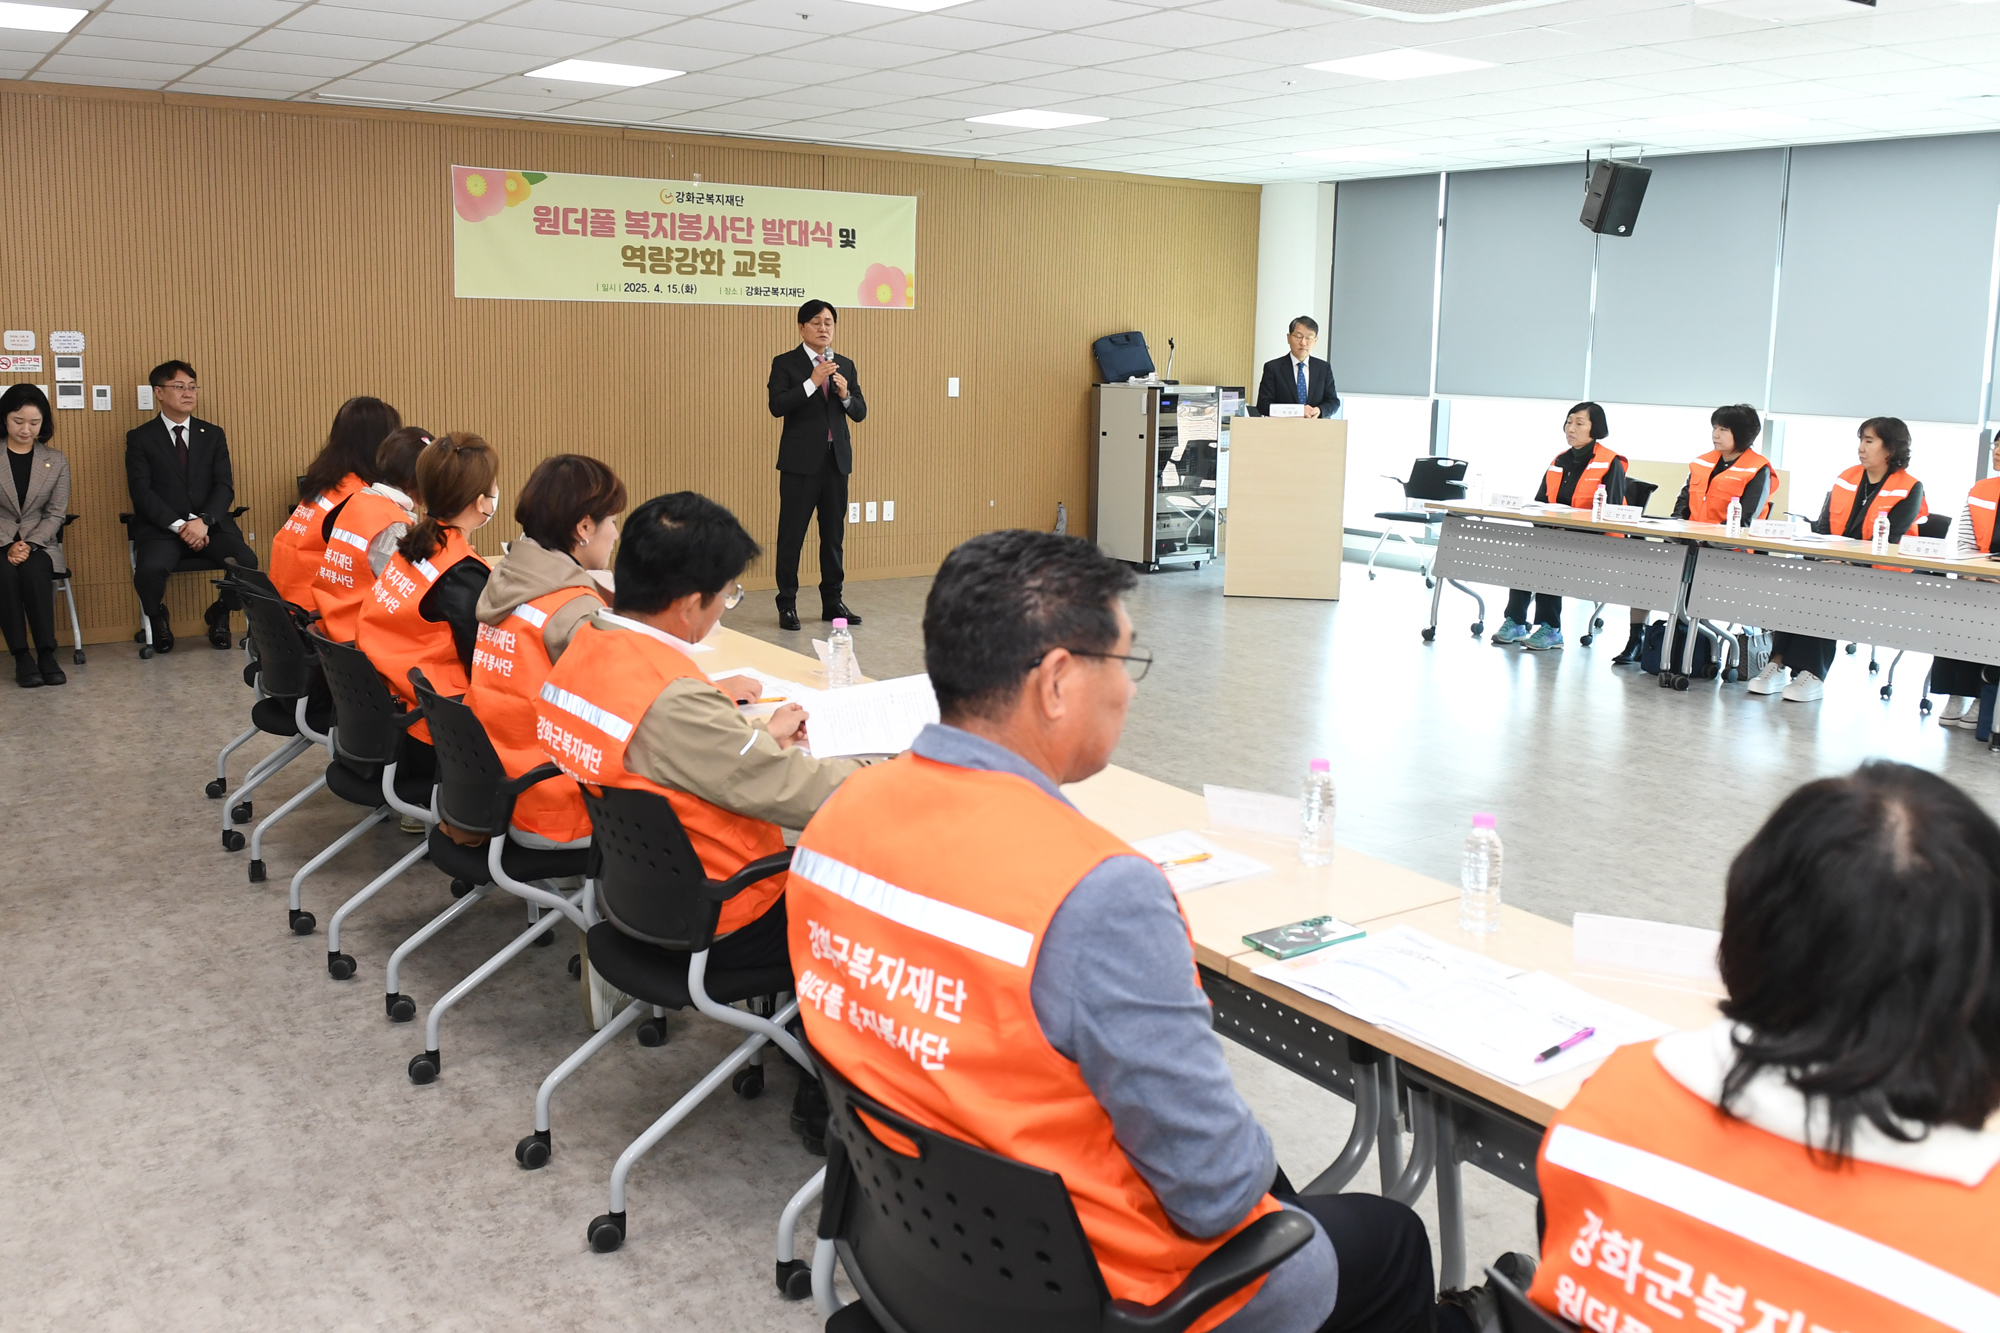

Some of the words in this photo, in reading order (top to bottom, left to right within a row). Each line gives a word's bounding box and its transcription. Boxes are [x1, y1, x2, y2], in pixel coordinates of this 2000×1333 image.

[675, 191, 744, 207] 강화군복지재단
[533, 205, 616, 238] 원더풀
[625, 209, 755, 245] 복지봉사단
[761, 218, 833, 248] 발대식
[838, 228, 857, 249] 및
[621, 245, 726, 276] 역량강화
[732, 250, 781, 278] 교육
[623, 282, 650, 293] 2025.
[653, 284, 663, 294] 4.
[667, 283, 697, 295] 15.(화)
[745, 286, 805, 298] 강화군복지재단
[536, 715, 602, 775] 강화군복지재단
